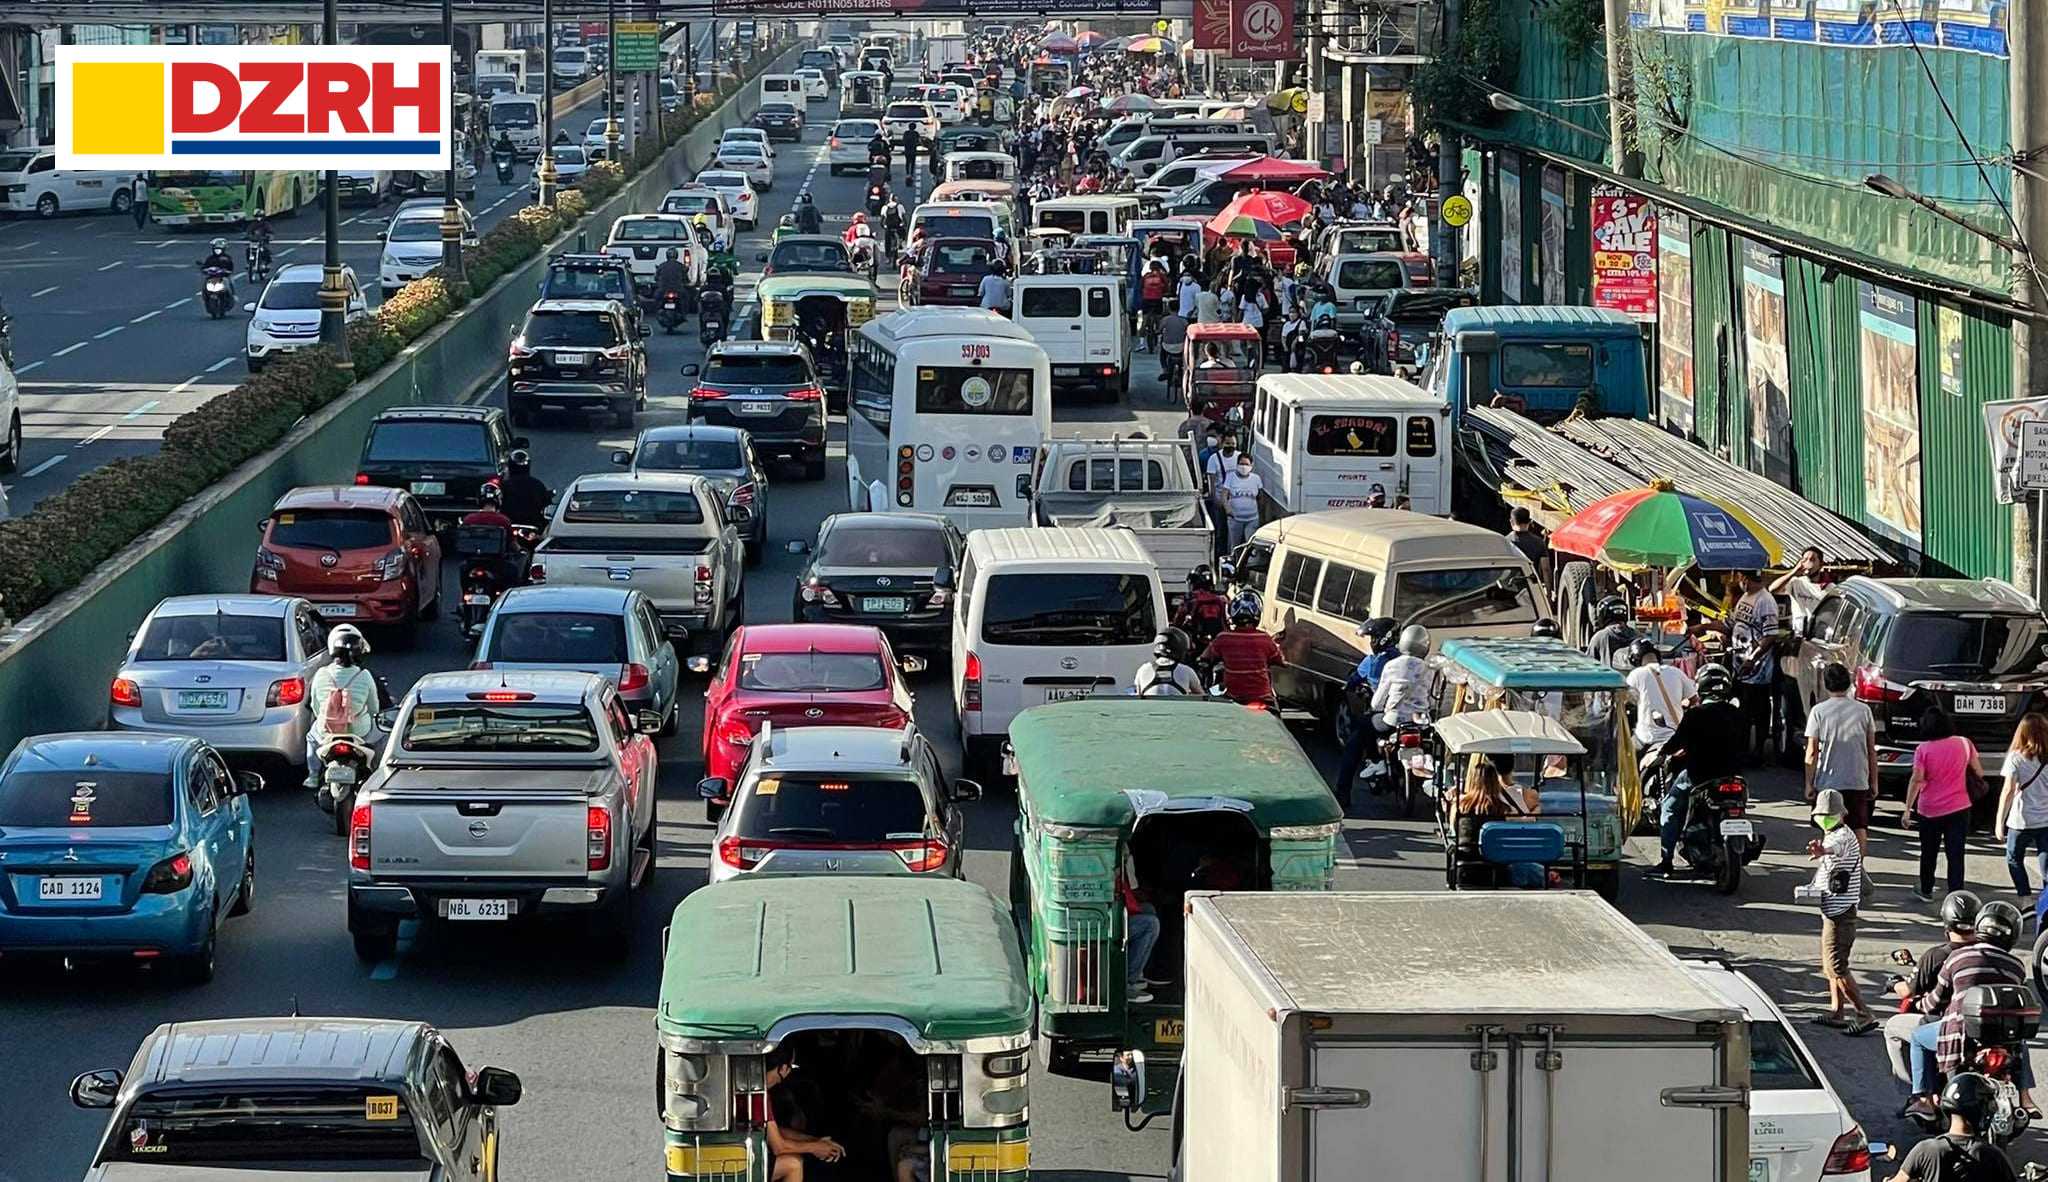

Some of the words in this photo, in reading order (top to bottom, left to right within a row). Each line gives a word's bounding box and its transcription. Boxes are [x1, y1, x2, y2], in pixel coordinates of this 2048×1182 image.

[1096, 0, 1116, 9] your
[1247, 6, 1277, 35] Ck
[1600, 231, 1652, 251] SALE
[1327, 499, 1345, 508] KEEP
[41, 882, 64, 895] CAD
[71, 882, 100, 895] 1124
[450, 903, 471, 916] NBL
[478, 903, 505, 916] 6231
